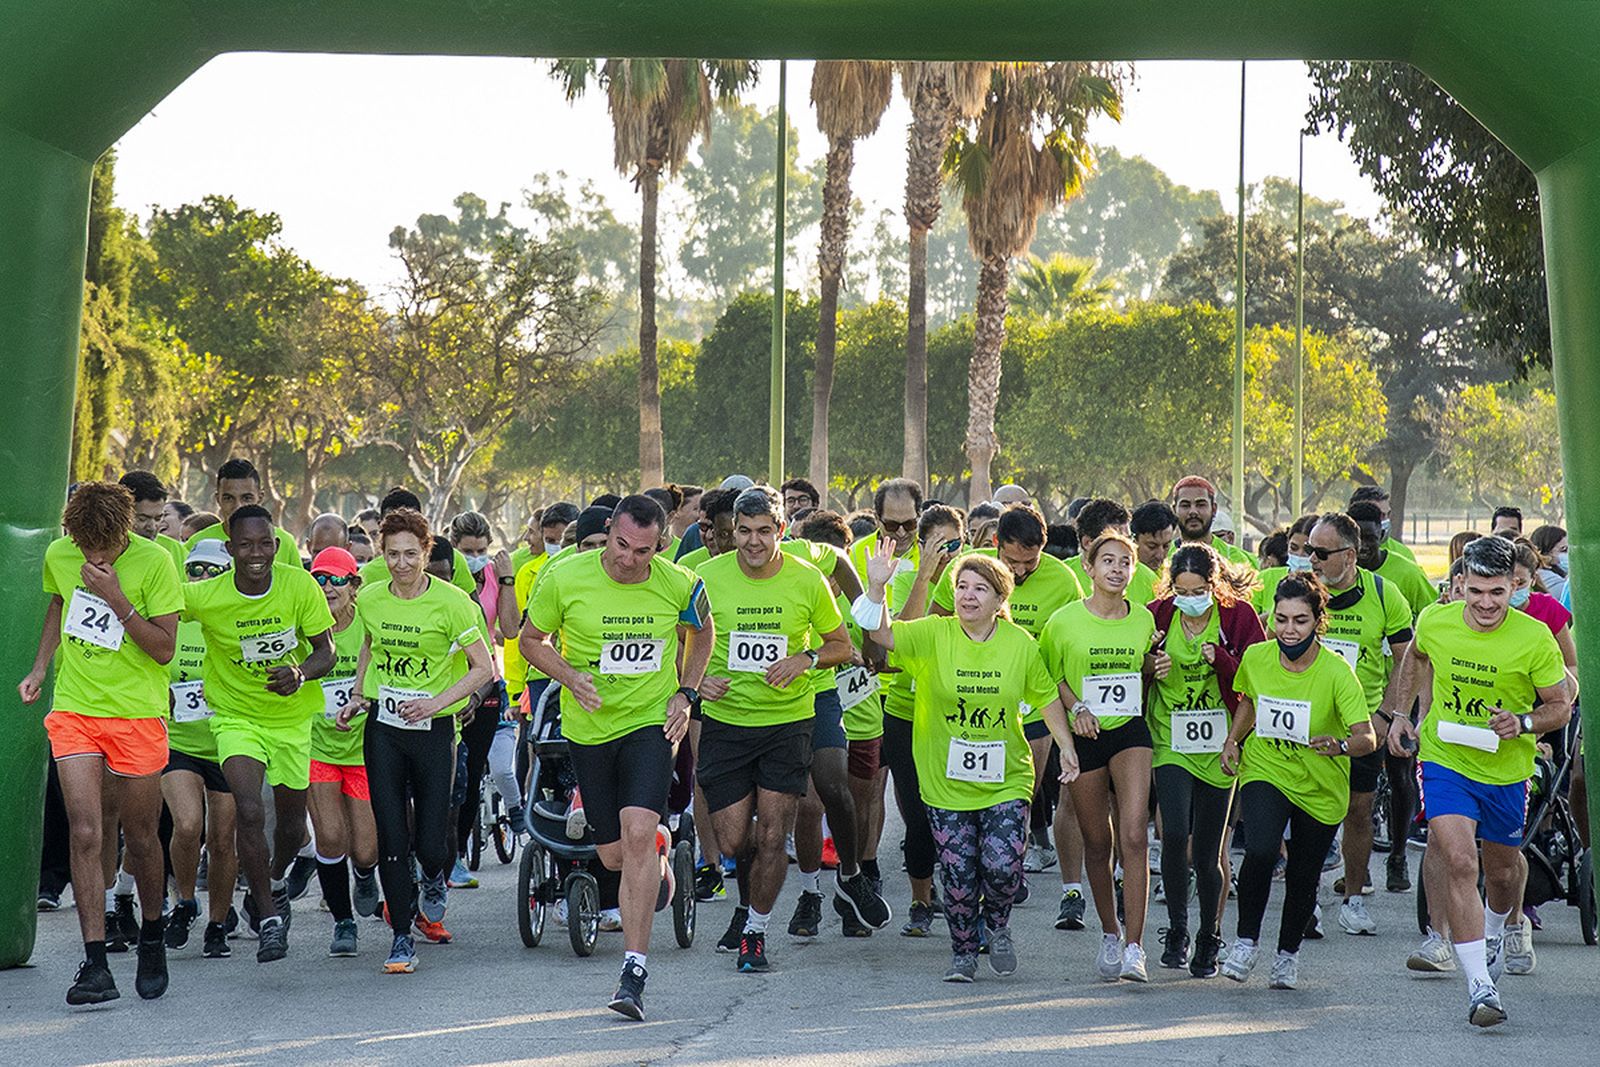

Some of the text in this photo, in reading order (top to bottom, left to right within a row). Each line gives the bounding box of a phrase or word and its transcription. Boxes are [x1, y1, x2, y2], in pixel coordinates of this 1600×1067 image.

[763, 607, 774, 615] por
[81, 607, 110, 633] 24
[236, 616, 282, 628] Carrera por la
[602, 615, 654, 625] Carrera por la
[382, 622, 402, 631] Carrera
[737, 622, 781, 631] Salud Mental
[1340, 627, 1361, 635] Mental
[602, 632, 652, 640] Salud Mental
[181, 644, 205, 653] Carrera
[256, 639, 285, 654] 26
[381, 637, 419, 648] Salud Mental
[610, 643, 655, 662] 002
[737, 642, 779, 662] 003
[179, 659, 197, 667] Salud
[1452, 657, 1476, 669] Carrera
[1490, 665, 1498, 673] la
[957, 669, 980, 677] Carrera
[982, 671, 993, 679] por
[848, 670, 868, 693] 44
[1451, 673, 1494, 688] Salud Mental
[957, 684, 999, 694] Salud Mental
[1099, 684, 1126, 703] 79
[1270, 708, 1295, 730] 70
[1186, 721, 1213, 741] 80
[963, 751, 988, 770] 81
